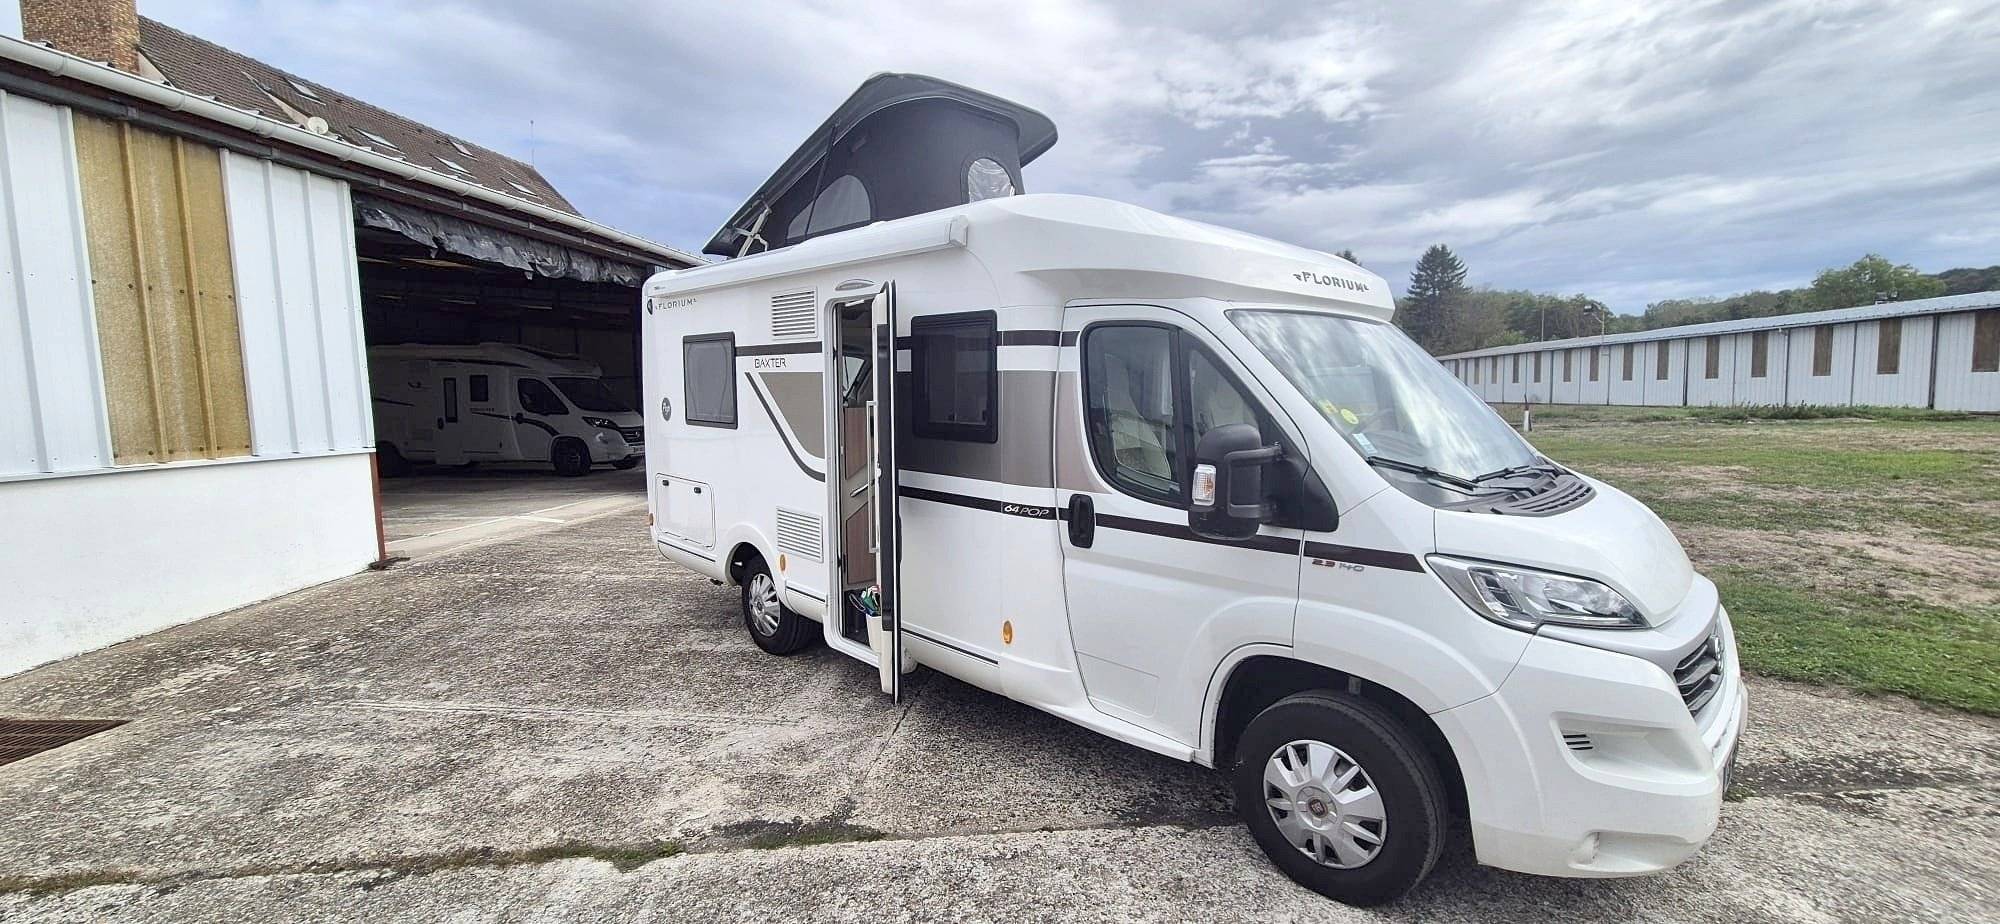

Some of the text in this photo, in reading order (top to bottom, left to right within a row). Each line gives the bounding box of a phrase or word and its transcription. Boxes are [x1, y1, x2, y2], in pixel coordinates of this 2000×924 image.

[1300, 271, 1365, 292] FLORIUM
[658, 299, 694, 310] FLORIUM
[754, 357, 787, 368] BAXTER
[1004, 504, 1050, 516] 64 POP
[1338, 562, 1365, 572] 140
